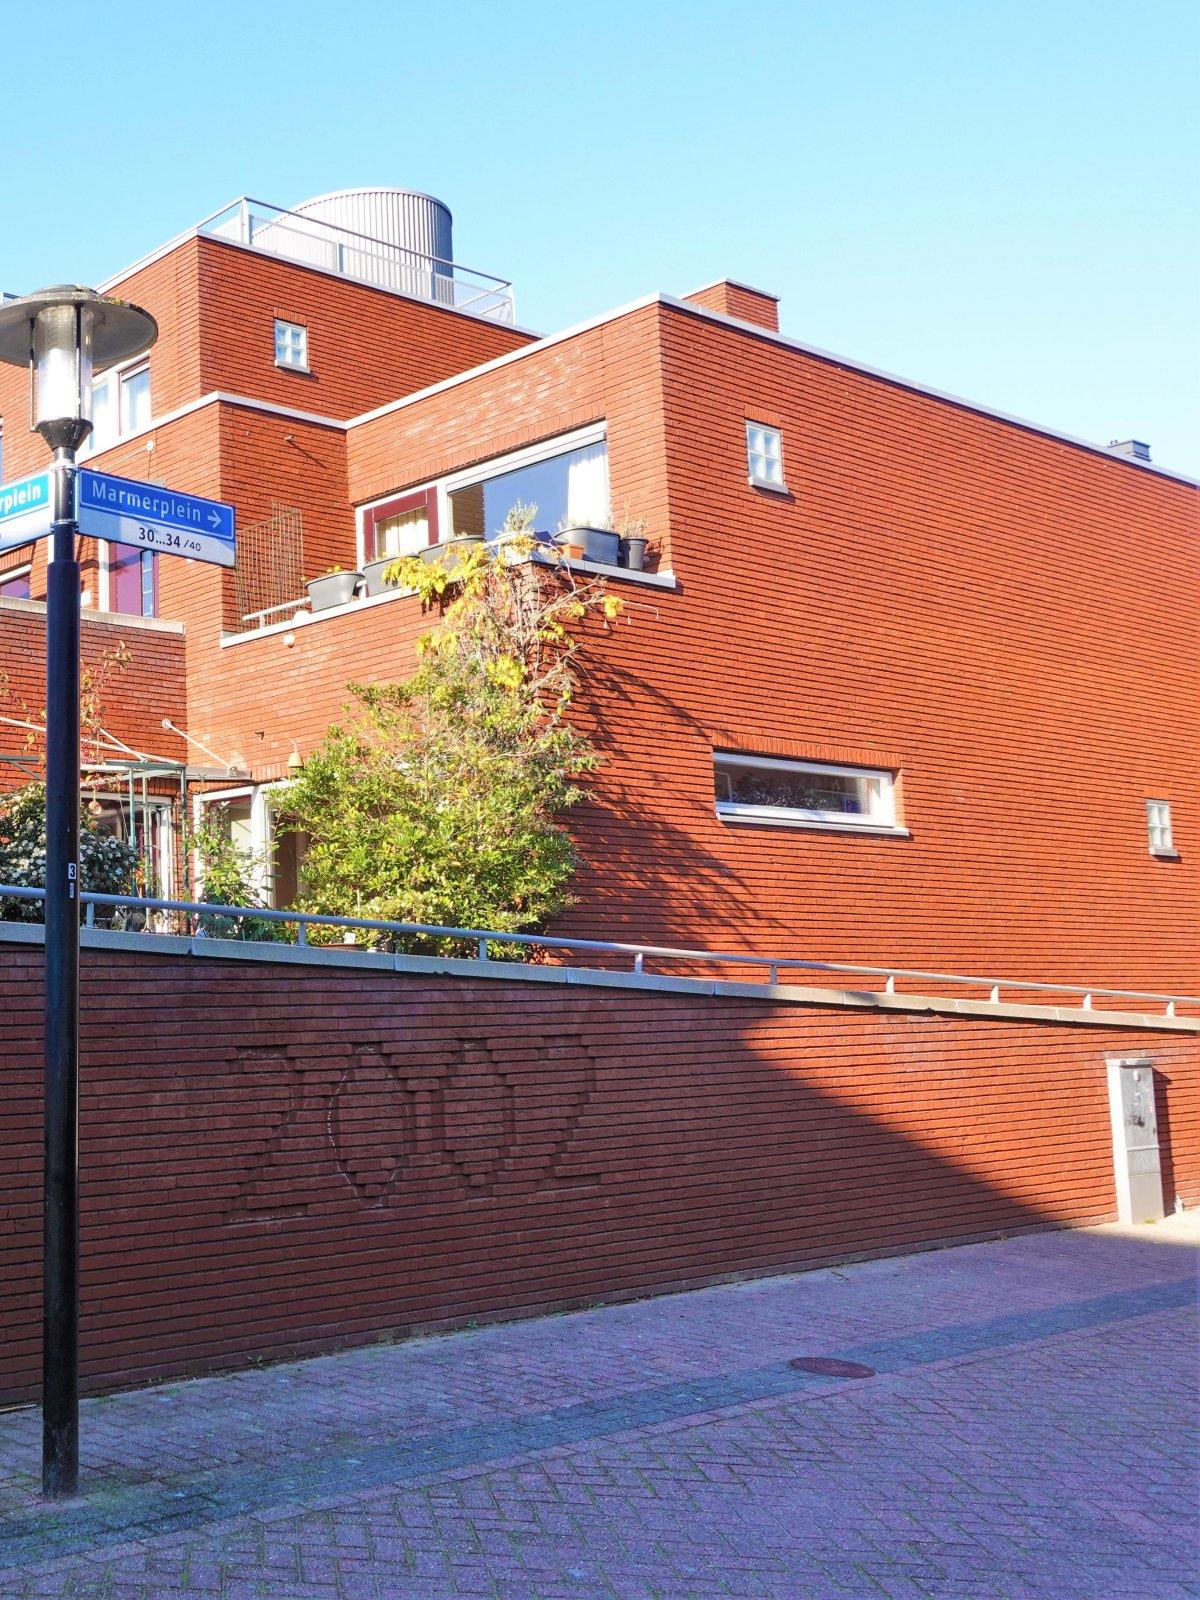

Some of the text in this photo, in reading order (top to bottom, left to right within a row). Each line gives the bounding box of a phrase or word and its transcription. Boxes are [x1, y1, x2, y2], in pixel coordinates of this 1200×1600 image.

[92, 480, 201, 522] Marmerplein
[69, 864, 76, 878] 3
[222, 1035, 603, 1222] 2002
